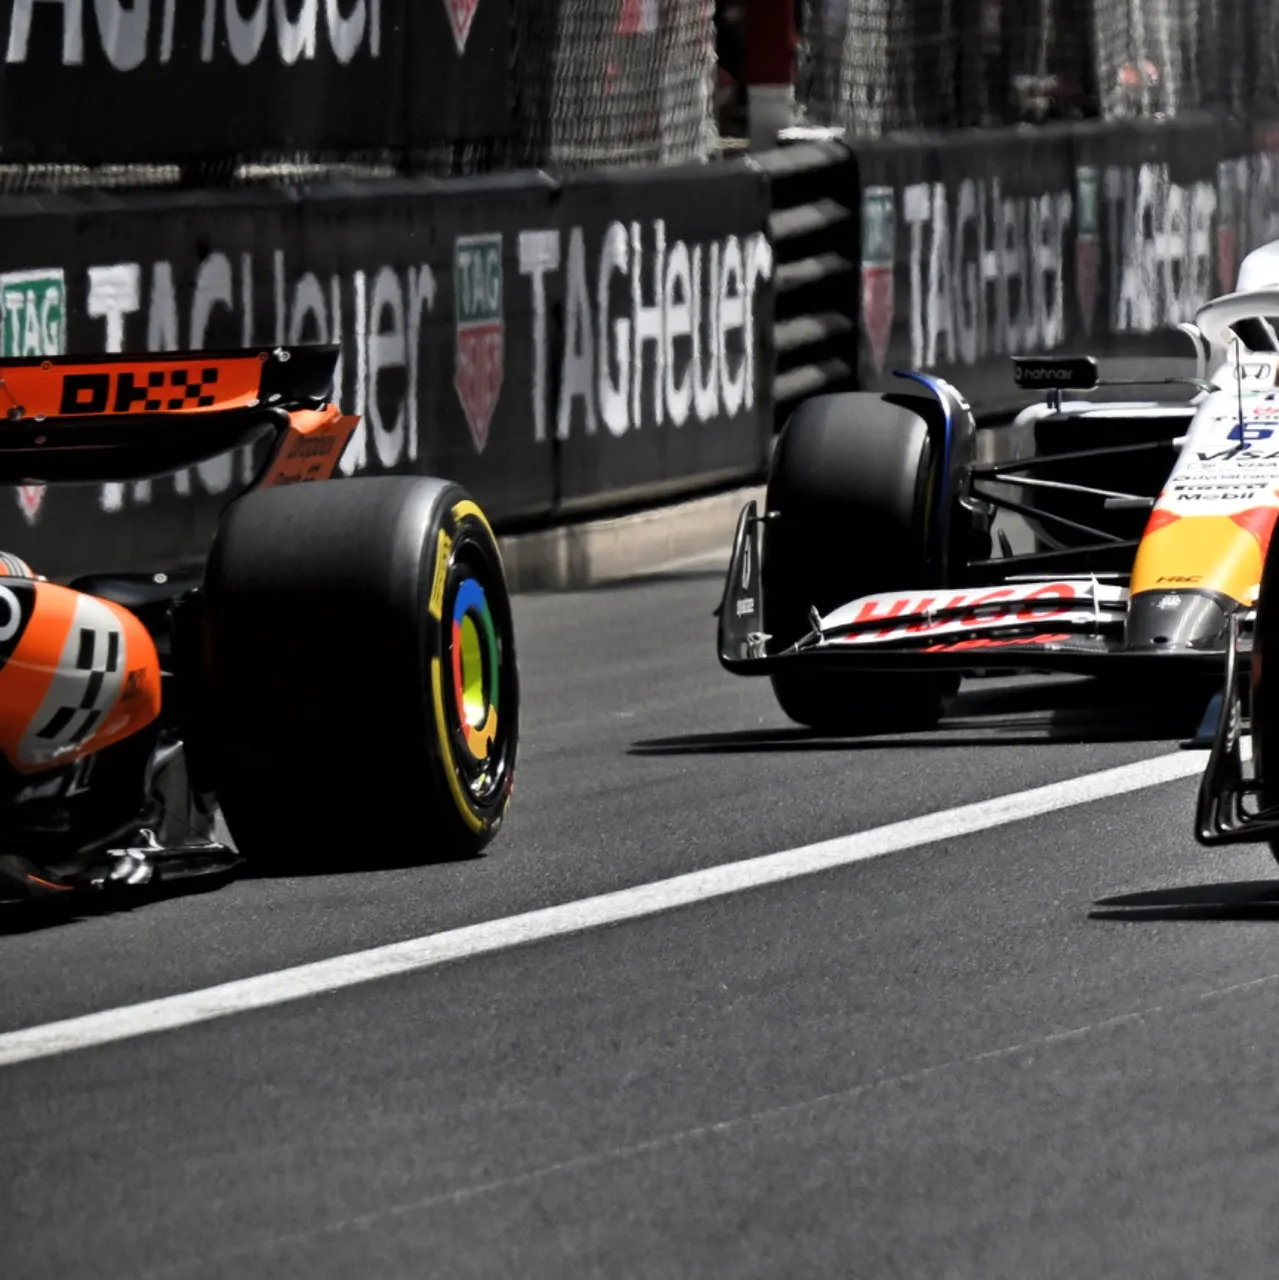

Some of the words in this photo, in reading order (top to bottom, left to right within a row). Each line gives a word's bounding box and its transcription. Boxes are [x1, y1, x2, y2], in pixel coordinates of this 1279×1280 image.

[458, 253, 501, 313] TAG
[2, 287, 61, 355] TAG
[59, 368, 218, 414] OKX
